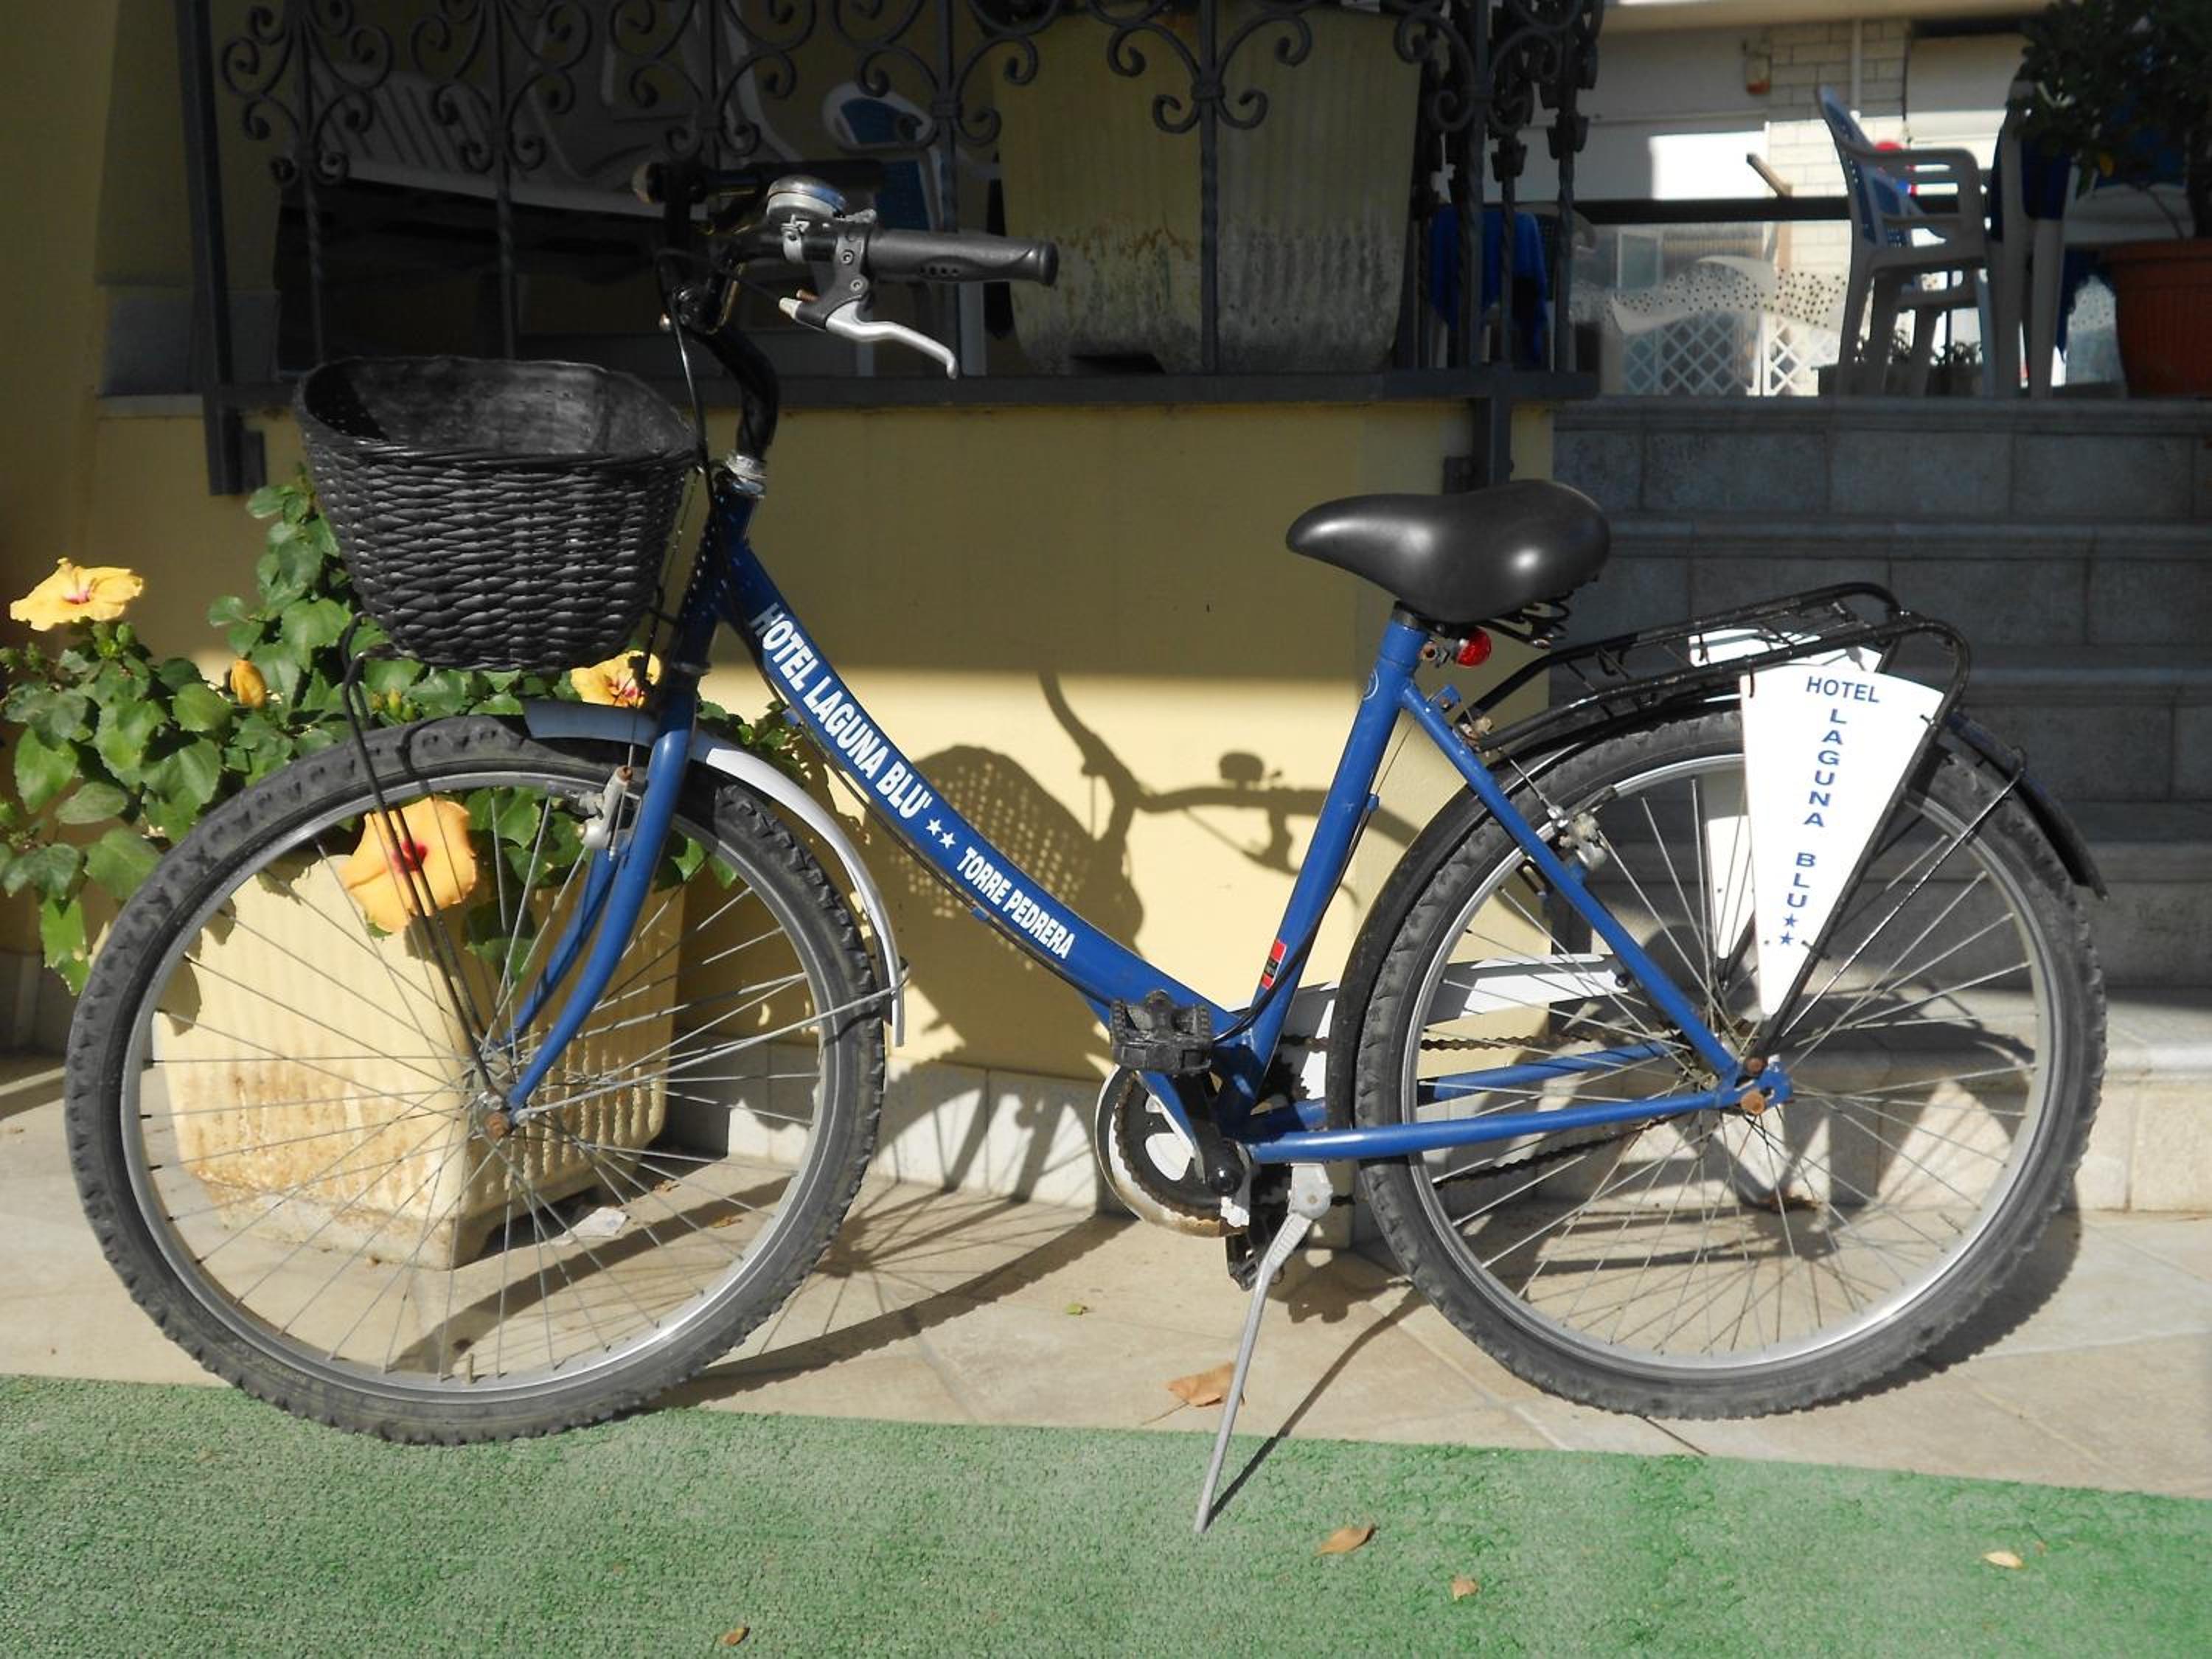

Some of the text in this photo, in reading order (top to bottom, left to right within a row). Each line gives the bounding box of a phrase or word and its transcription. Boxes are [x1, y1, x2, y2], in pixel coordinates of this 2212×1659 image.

[749, 602, 819, 692] HOTEL
[803, 675, 888, 779] LAGUNA
[957, 846, 1012, 905] TORRE
[1002, 888, 1075, 959] PEDRERA
[1806, 675, 1880, 703] HOTEL
[1787, 708, 1848, 908] LAGUNA BLU
